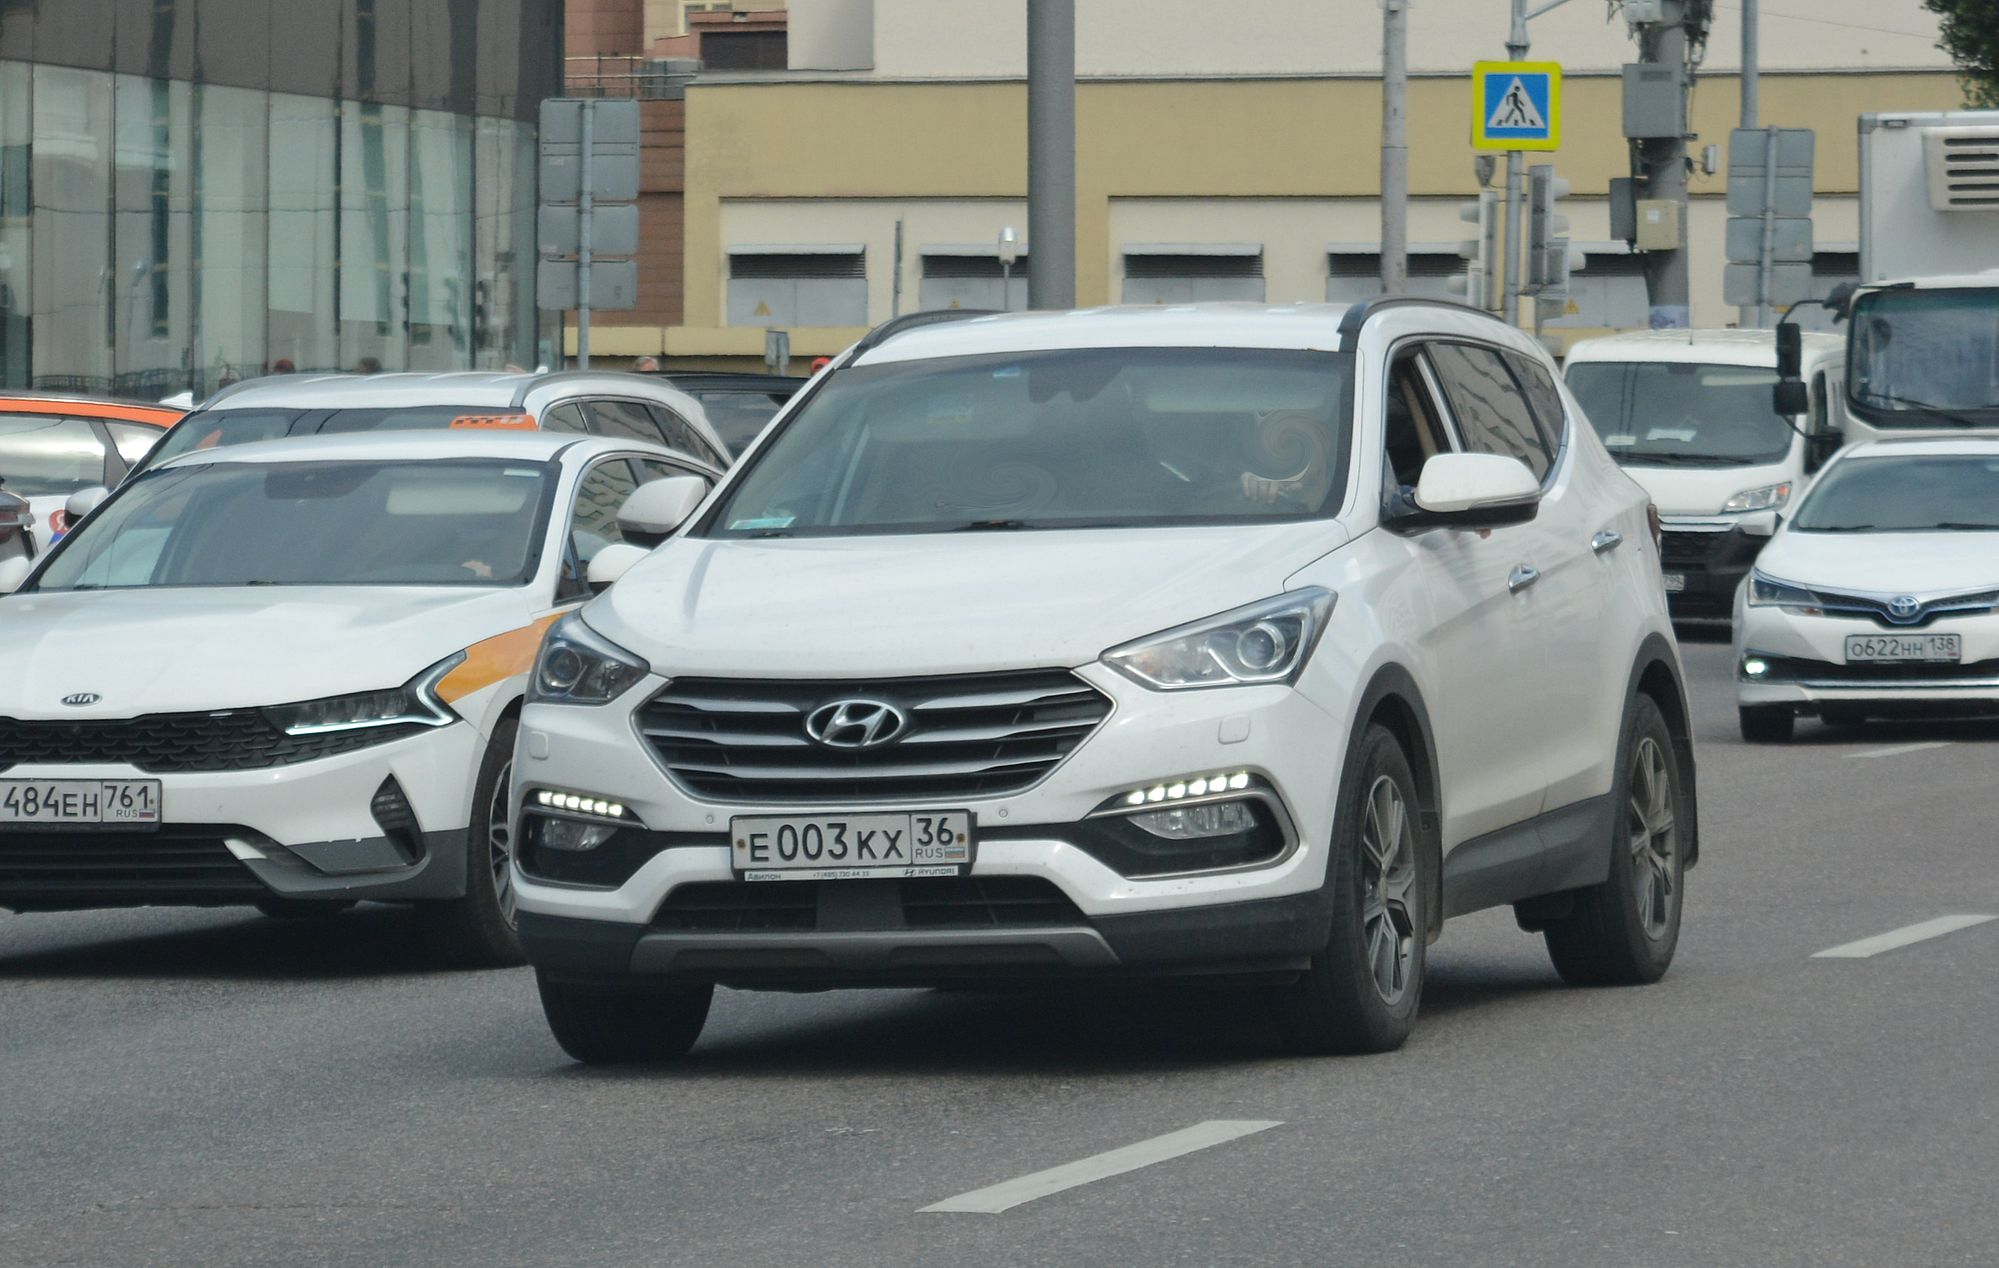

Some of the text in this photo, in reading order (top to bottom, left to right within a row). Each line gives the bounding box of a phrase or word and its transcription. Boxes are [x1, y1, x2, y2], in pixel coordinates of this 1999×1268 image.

[1928, 637, 1956, 651] 138
[66, 694, 94, 703] KIA
[104, 785, 149, 809] 761
[116, 809, 138, 818] RUS
[915, 817, 954, 847] 36
[915, 847, 943, 859] RUS
